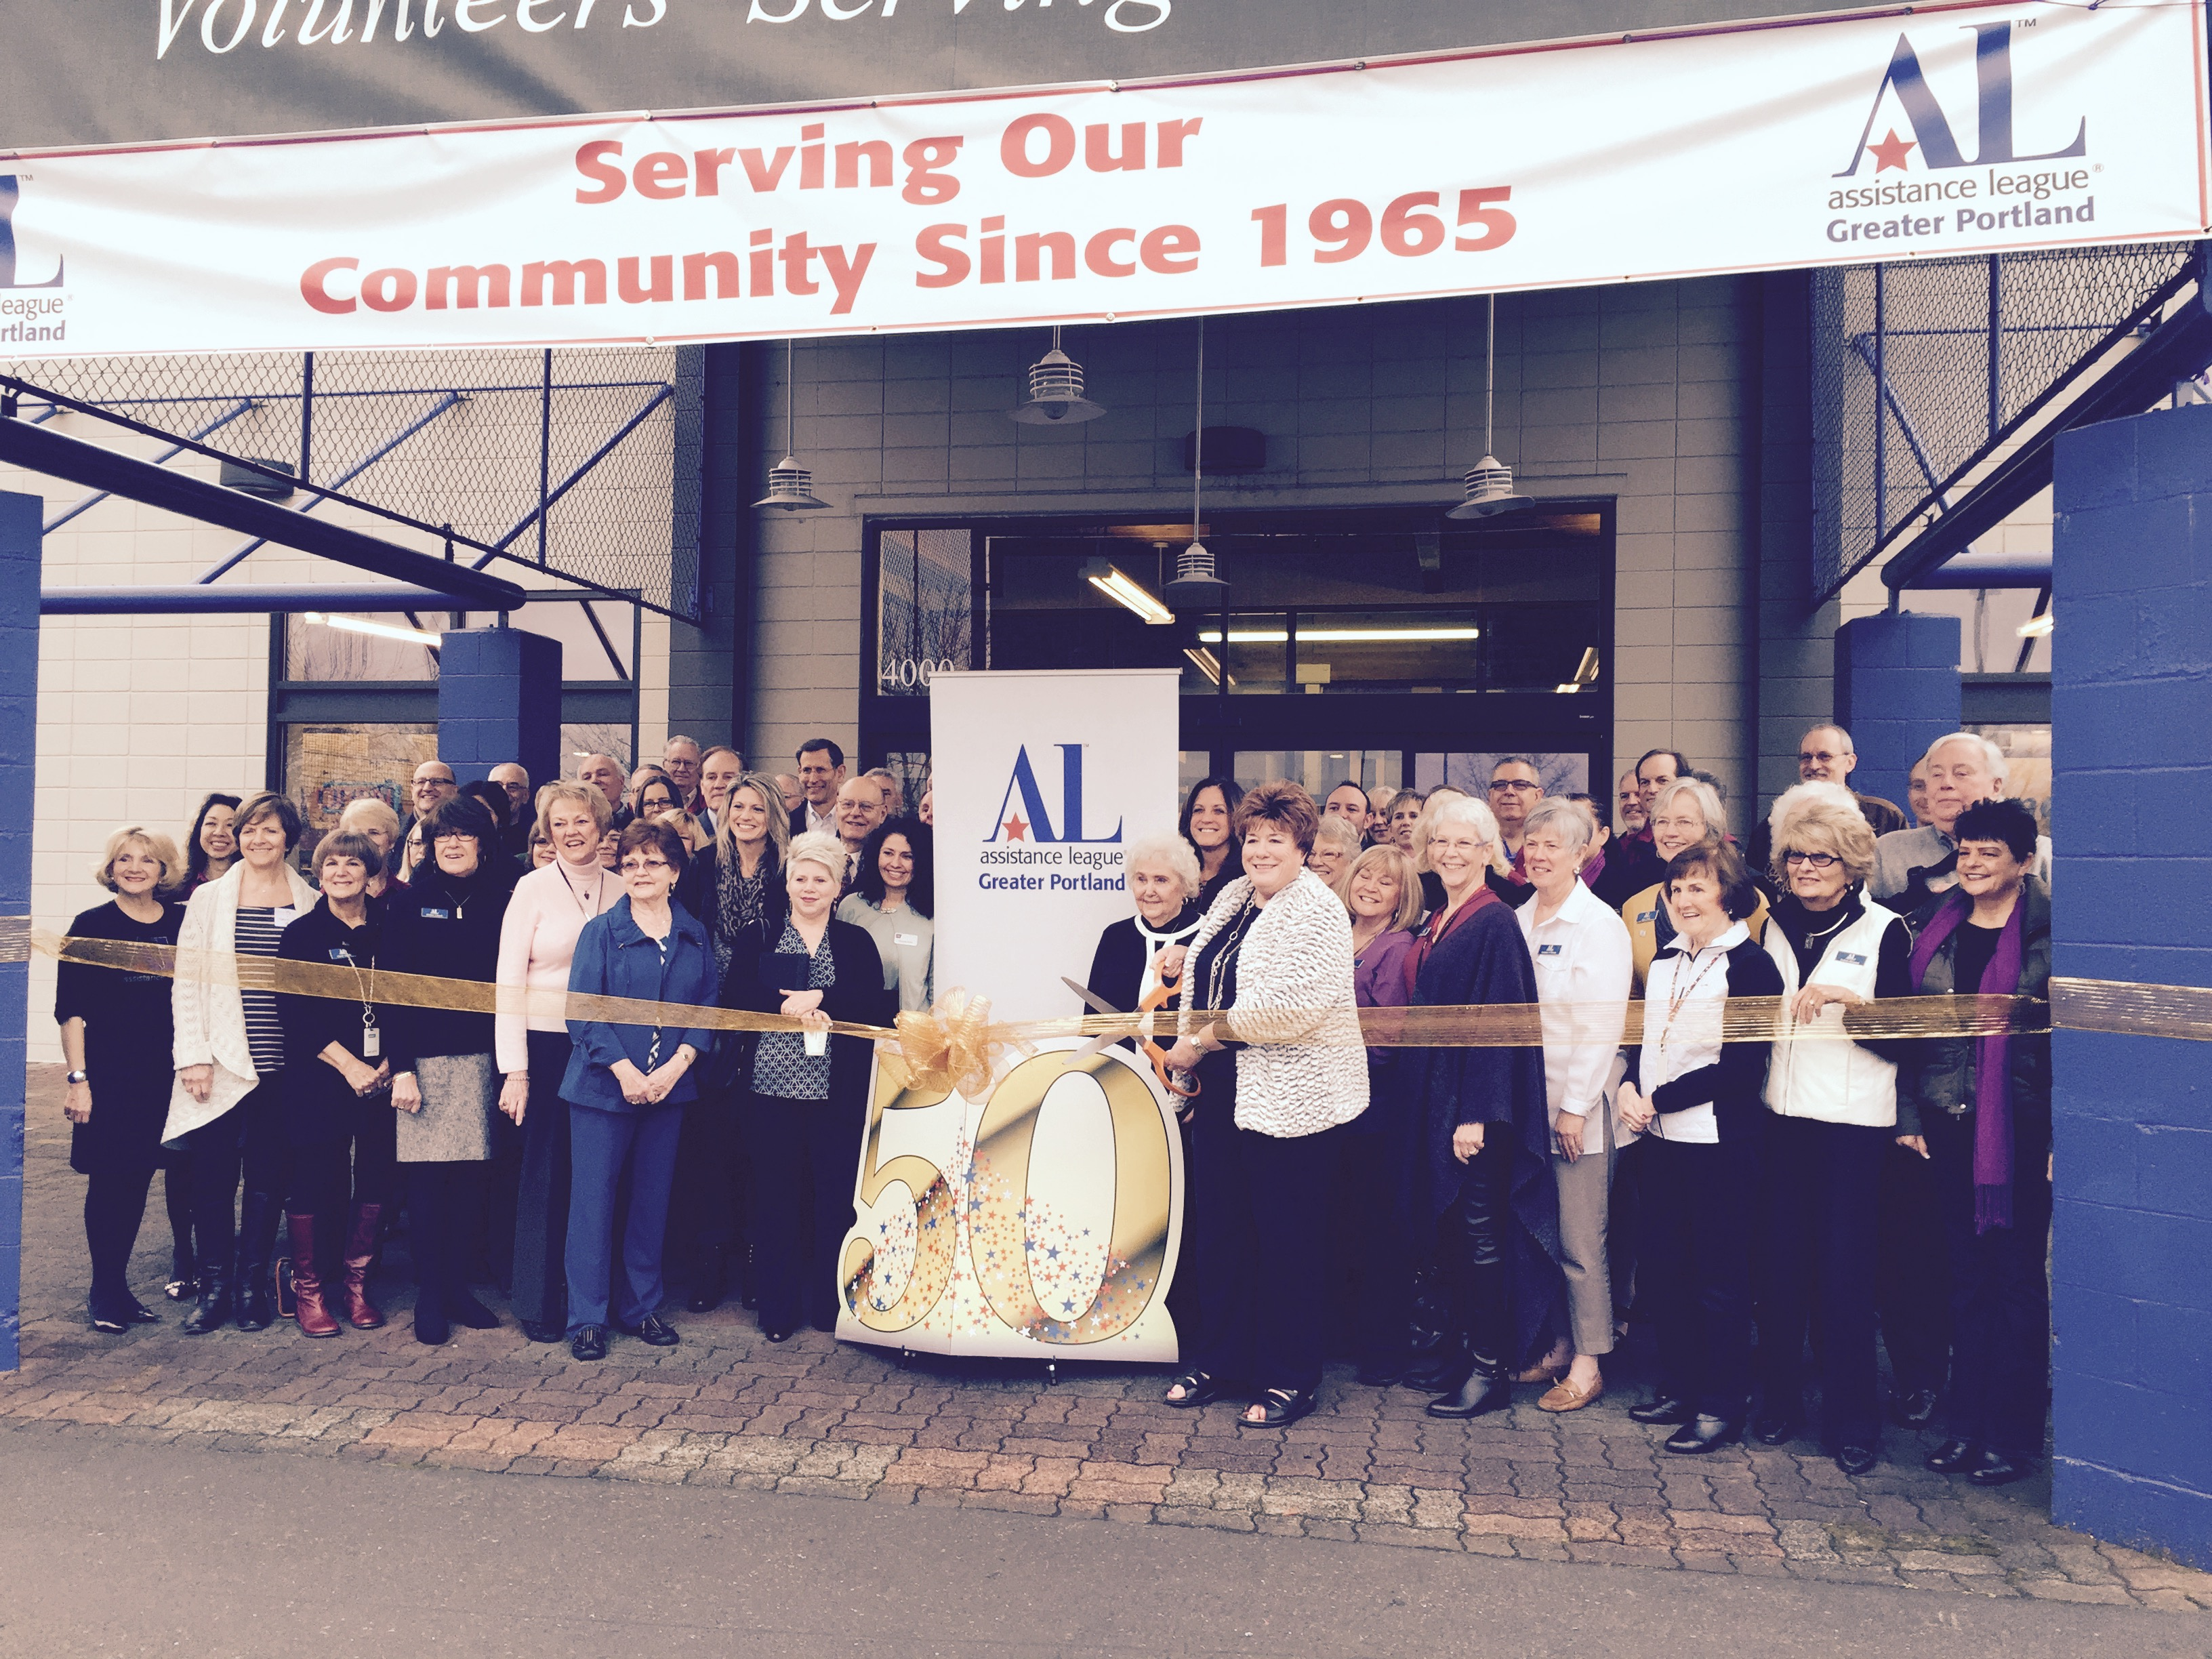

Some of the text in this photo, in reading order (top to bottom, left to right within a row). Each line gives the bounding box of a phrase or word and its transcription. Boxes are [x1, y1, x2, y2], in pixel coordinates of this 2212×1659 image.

[1831, 20, 2086, 178] AL
[575, 112, 1204, 206] Serving Our
[1828, 169, 2089, 210] assistance league
[1826, 196, 2095, 243] Greater Portland
[300, 185, 1517, 316] Community Since 1965
[0, 297, 64, 321] eague
[0, 320, 66, 342] rtland
[982, 743, 1122, 843] AL
[979, 872, 1126, 891] Greater Portland
[980, 846, 1124, 870] assistance league
[844, 1048, 1171, 1346] 50
